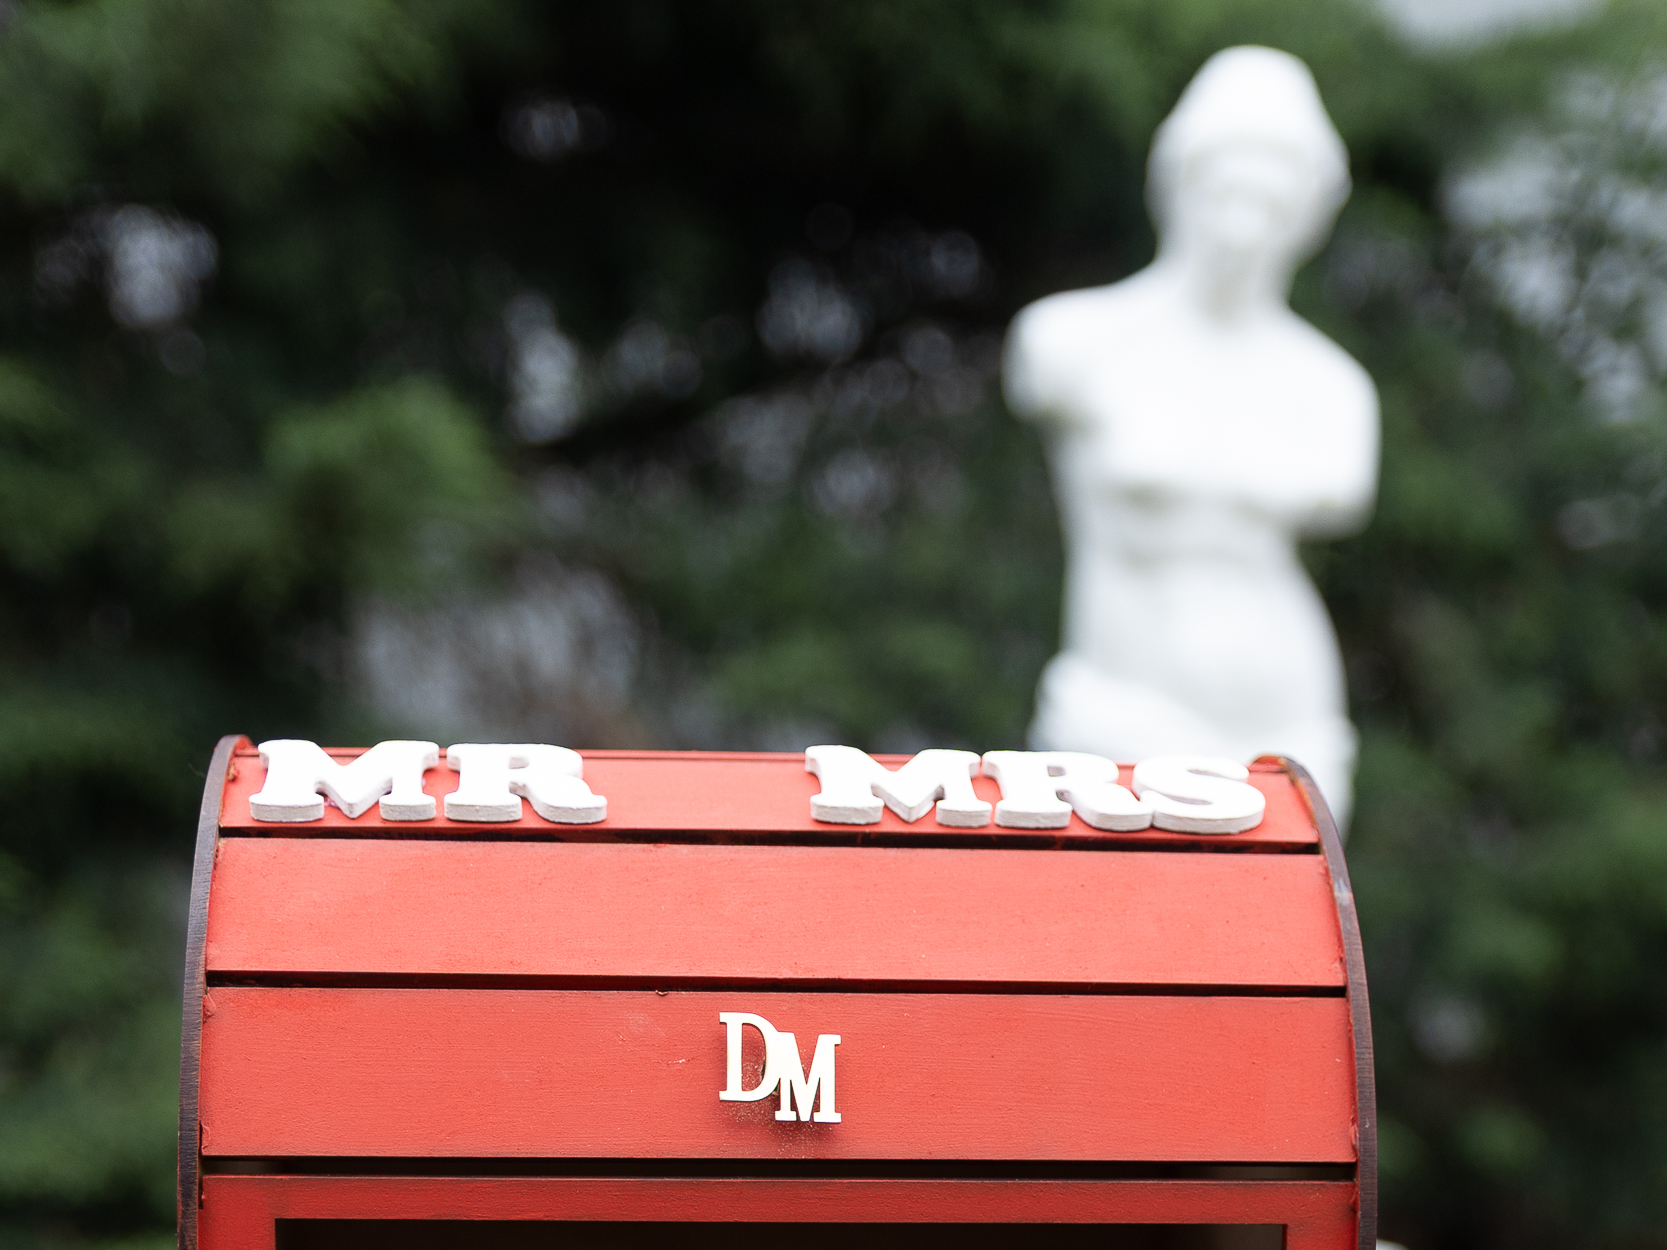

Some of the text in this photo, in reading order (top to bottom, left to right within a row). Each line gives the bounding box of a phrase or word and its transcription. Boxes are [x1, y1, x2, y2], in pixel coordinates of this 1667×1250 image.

[250, 739, 1266, 836] MR MRS
[719, 1011, 842, 1124] DM
